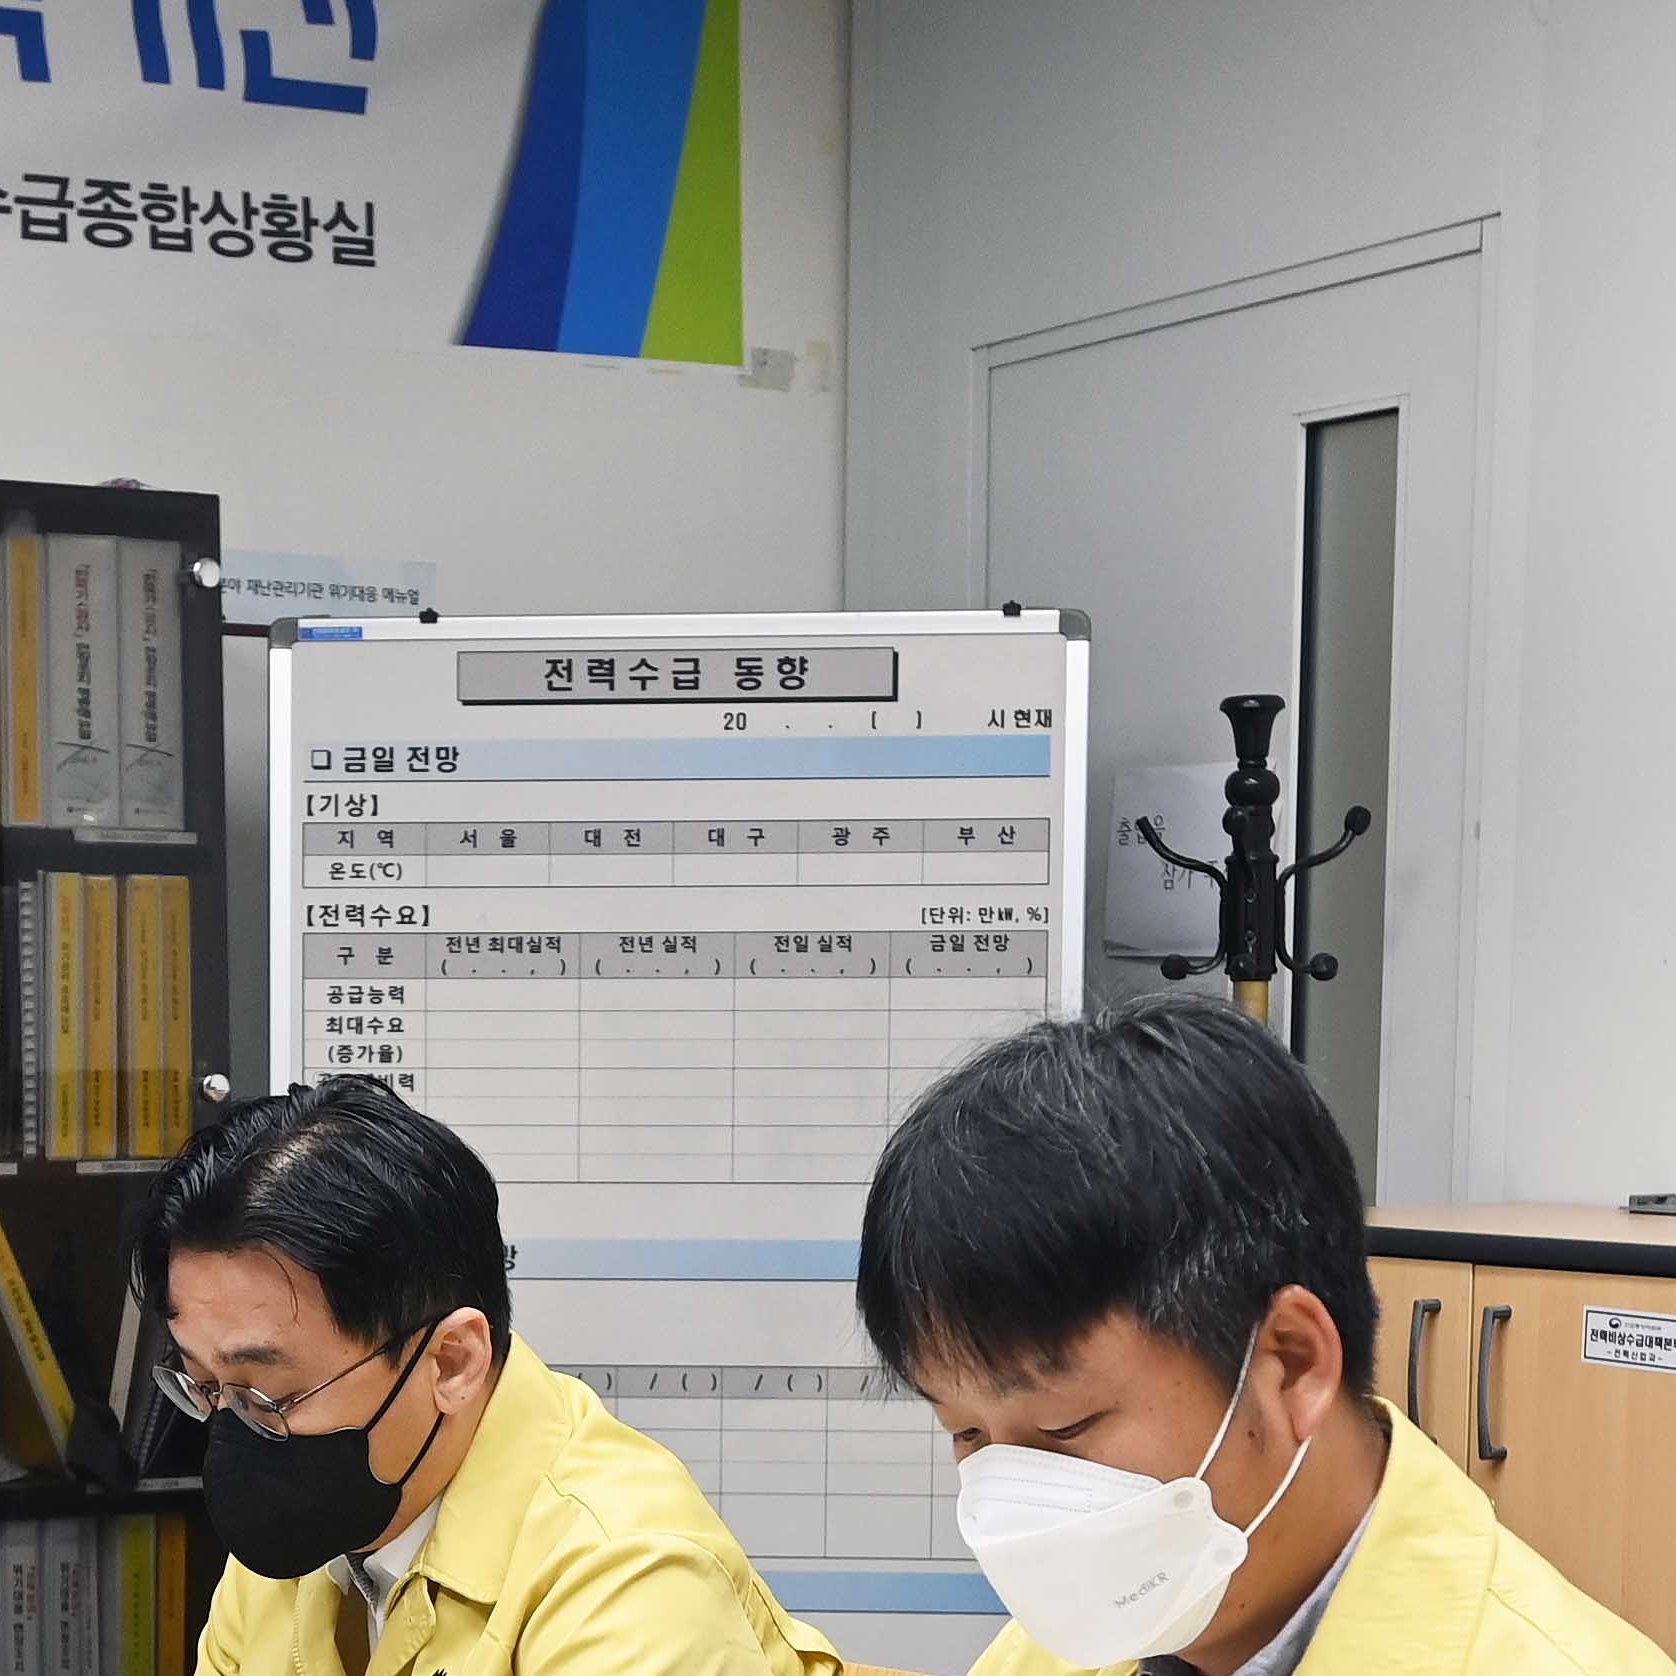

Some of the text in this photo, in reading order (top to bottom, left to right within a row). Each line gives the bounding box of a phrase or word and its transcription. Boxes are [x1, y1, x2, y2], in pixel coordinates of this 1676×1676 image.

[733, 655, 809, 691] 동향
[723, 712, 748, 732] 20
[1012, 708, 1053, 730] 현재
[342, 745, 460, 774] 금일 전망
[444, 934, 563, 955] 전년 최대실적
[618, 934, 699, 954] 전년 실적
[773, 934, 854, 954] 전일 실적
[928, 933, 1011, 953] 금일 전망
[325, 985, 406, 1006] 공급능력
[325, 1015, 406, 1035] 최대수요
[327, 1043, 404, 1065] (증가율)
